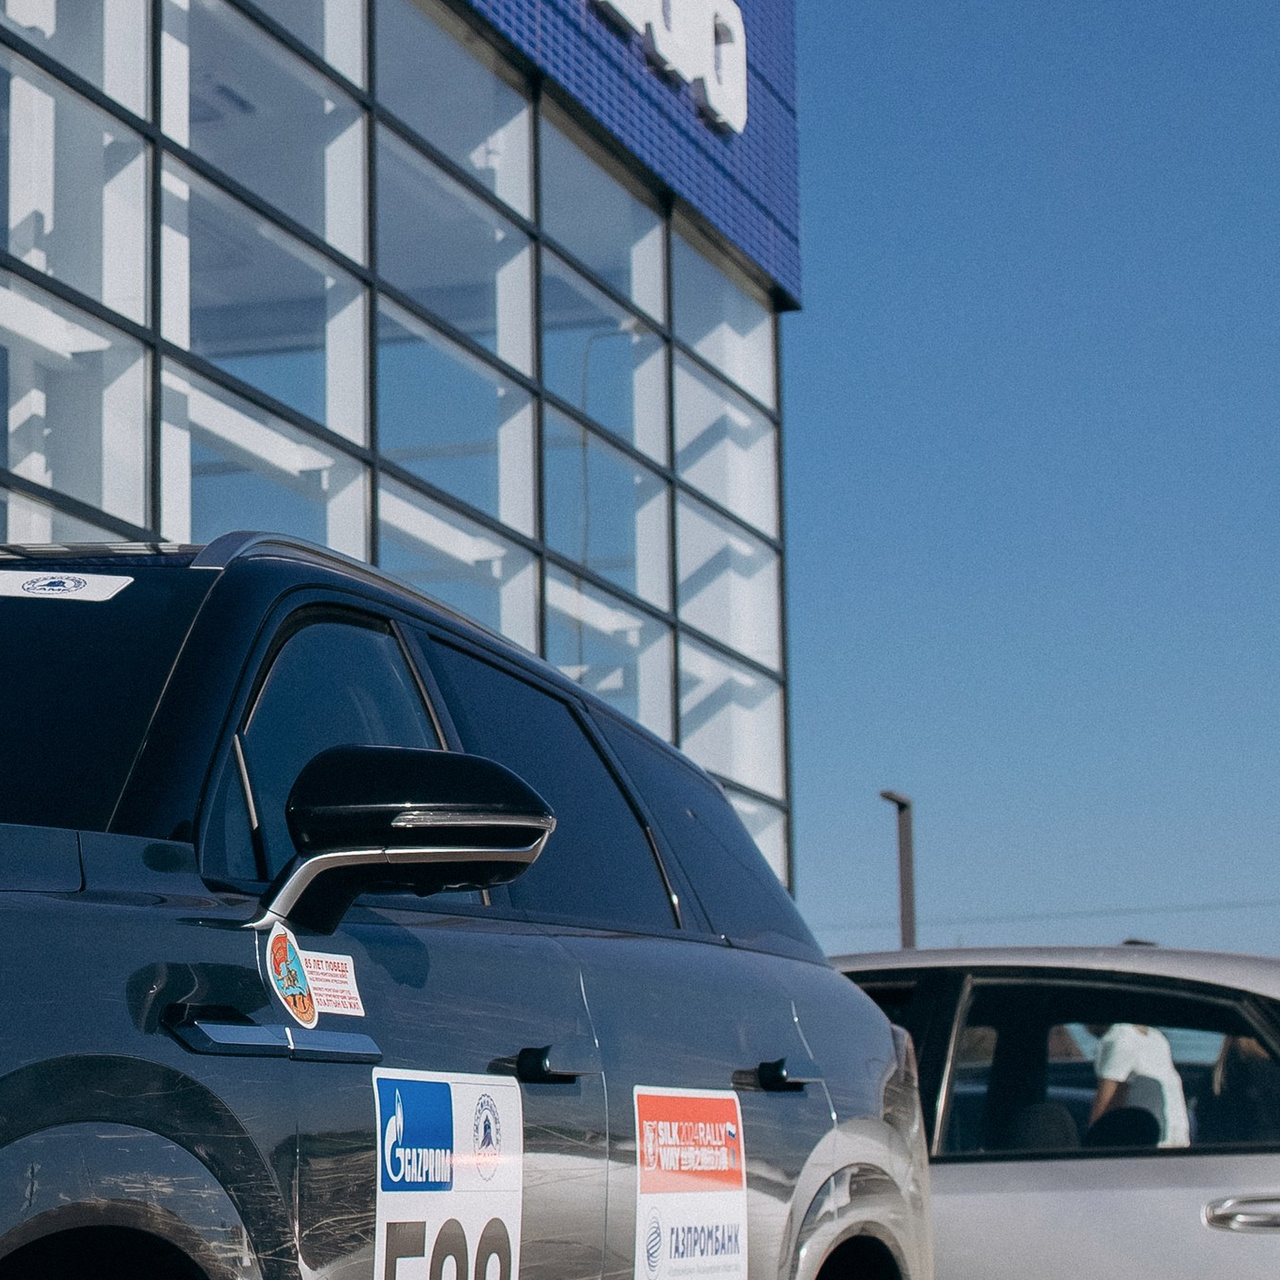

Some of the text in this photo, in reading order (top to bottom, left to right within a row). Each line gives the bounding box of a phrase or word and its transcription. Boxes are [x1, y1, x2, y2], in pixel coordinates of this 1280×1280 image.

[658, 1122, 679, 1145] SILK
[699, 1122, 726, 1145] RALLY
[405, 1148, 452, 1183] GAZPROM
[658, 1147, 680, 1171] WAY
[669, 1224, 741, 1259] ГАЗПРОМБАНК
